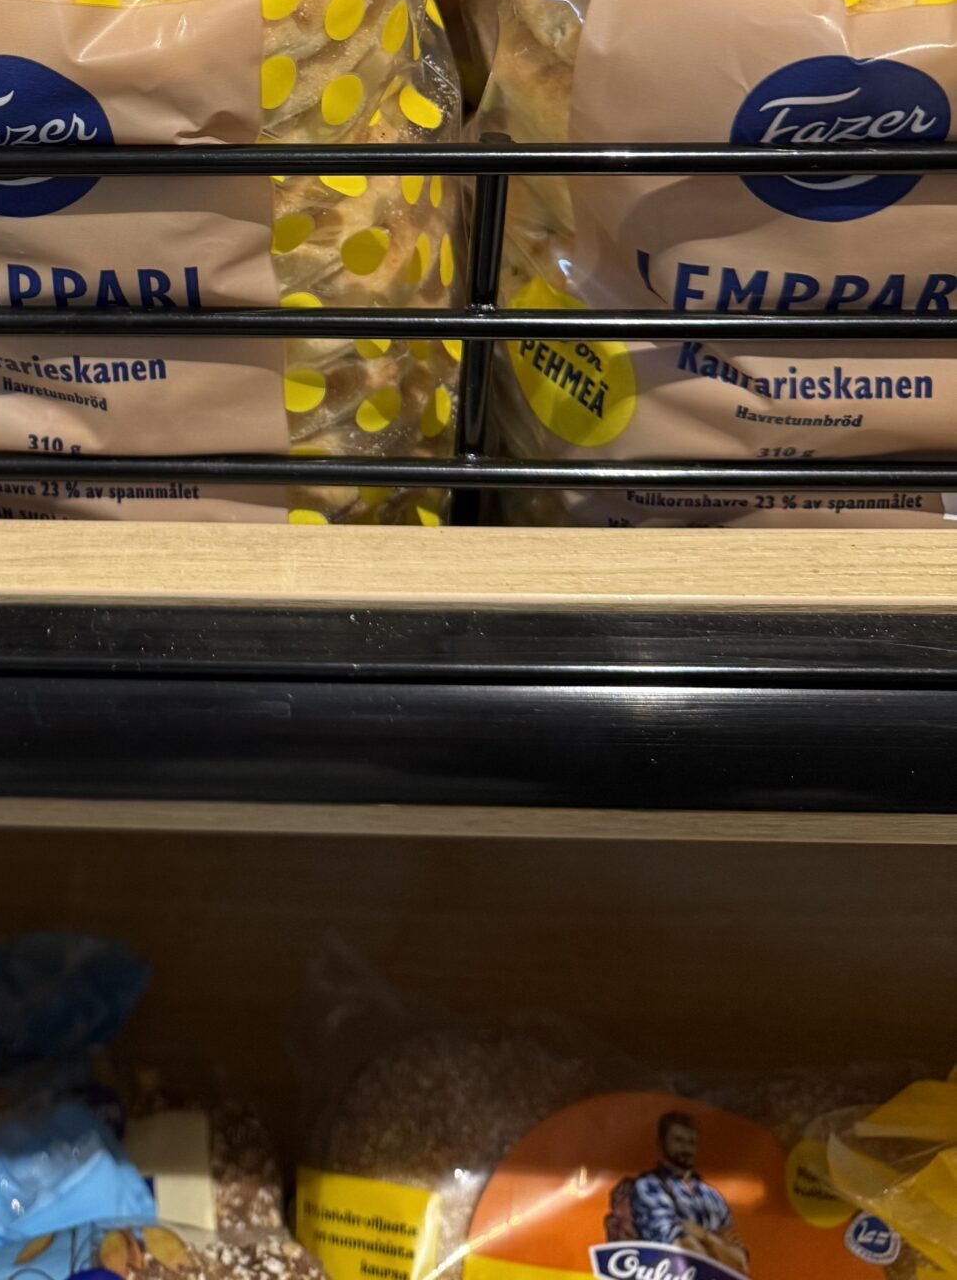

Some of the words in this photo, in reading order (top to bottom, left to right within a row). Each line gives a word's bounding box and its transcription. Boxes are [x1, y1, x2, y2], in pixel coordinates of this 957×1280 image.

[759, 87, 937, 143] Fazer
[518, 339, 609, 419] PEHMEÄ
[676, 341, 933, 400] Kaurarieskanen
[2, 376, 108, 411] Havretunnbröd
[735, 405, 863, 428] Havretunnbröd
[28, 433, 64, 453] 310
[756, 446, 796, 459] 310
[42, 481, 60, 498] 23
[65, 481, 81, 499] %
[86, 485, 104, 500] av
[109, 482, 201, 504] spannmålet
[754, 495, 776, 510] 23
[781, 495, 797, 510] %
[802, 498, 823, 510] av
[827, 493, 923, 513] spannmålet
